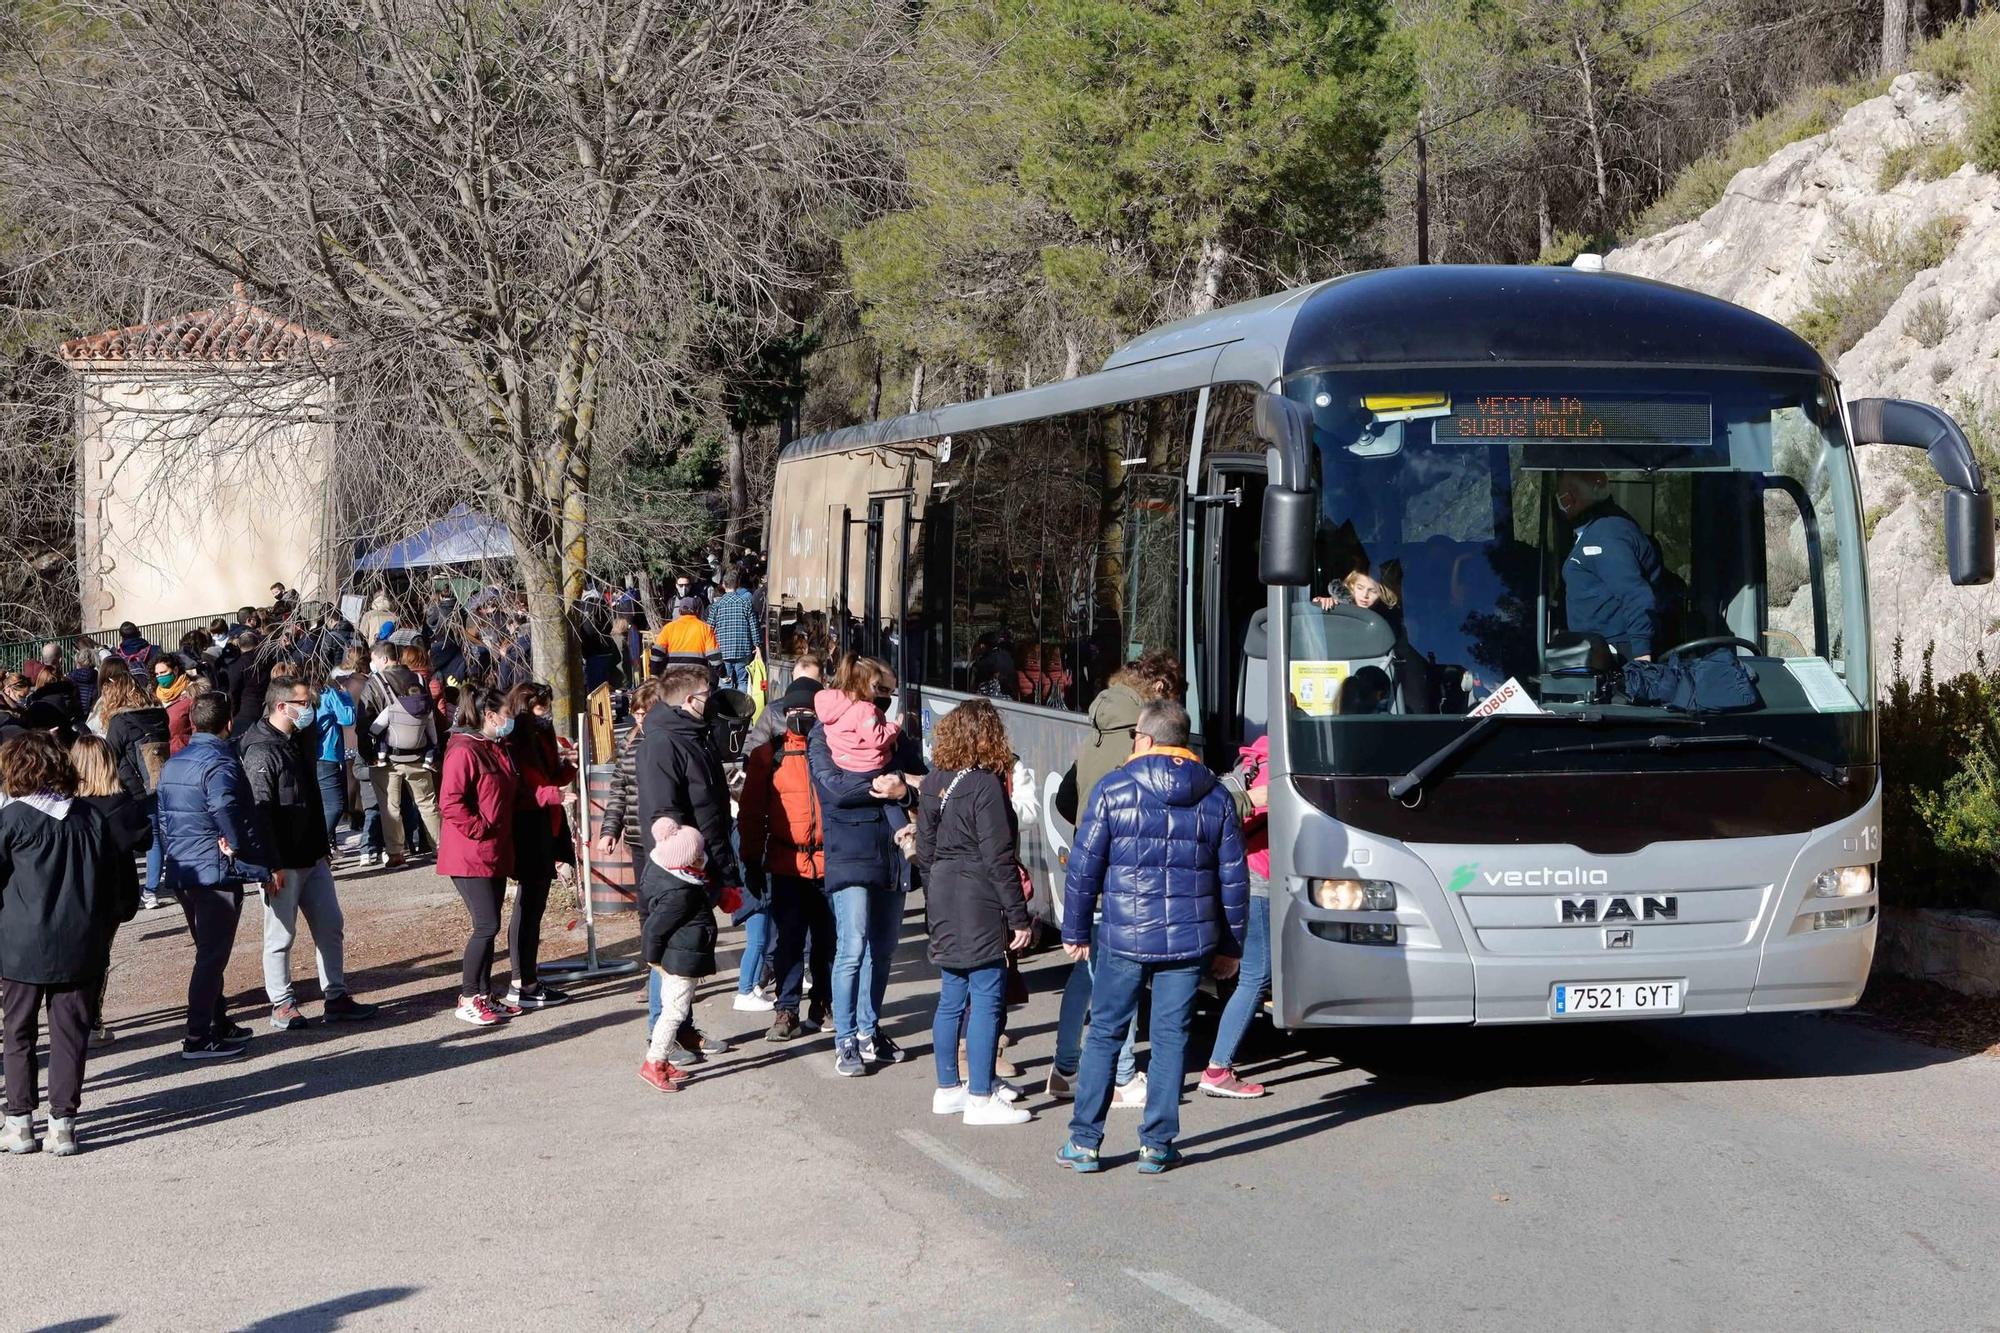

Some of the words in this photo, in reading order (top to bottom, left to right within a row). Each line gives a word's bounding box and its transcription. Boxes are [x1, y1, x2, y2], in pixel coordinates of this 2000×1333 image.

[1476, 397, 1584, 415] VECTALIA
[1457, 418, 1527, 436] SUBUS
[1535, 418, 1603, 437] MOLLA
[1484, 866, 1608, 887] vectalia
[1557, 896, 1678, 923] MAN
[1573, 987, 1622, 1010] 7521
[1635, 985, 1673, 1007] GYT
